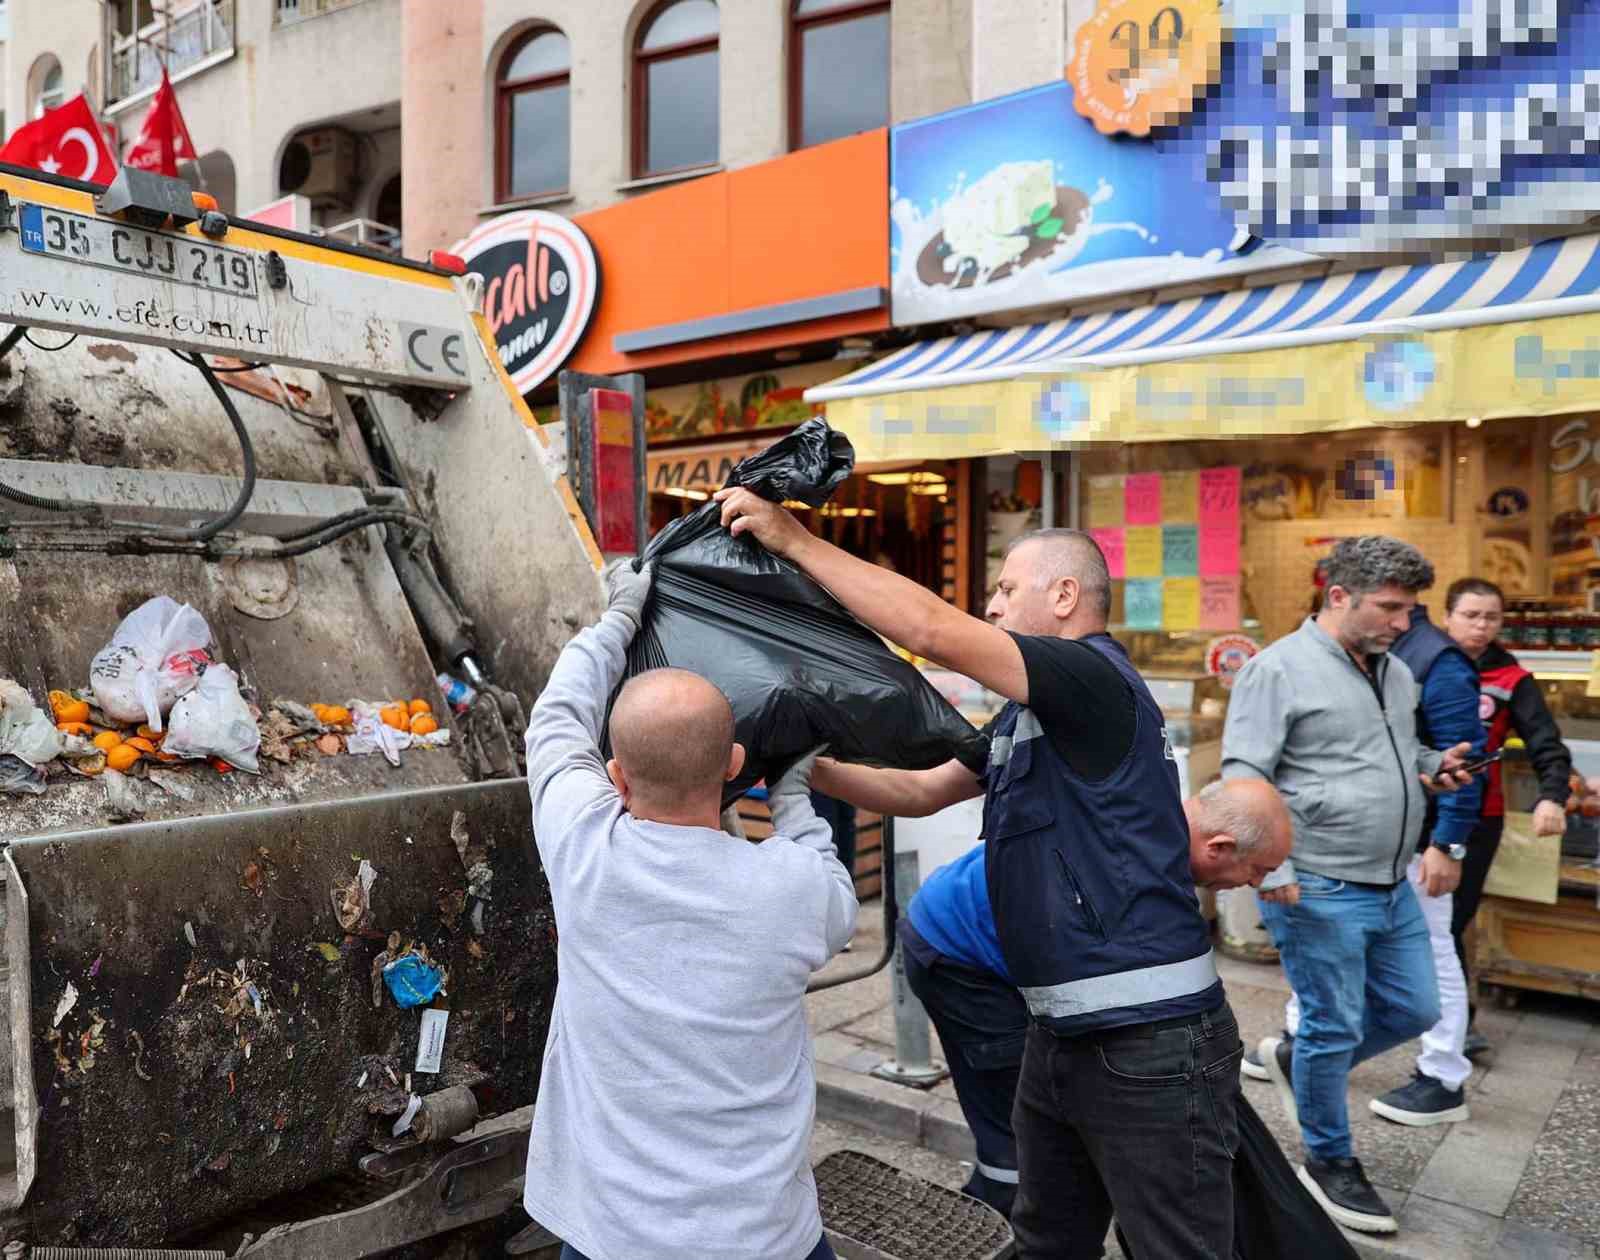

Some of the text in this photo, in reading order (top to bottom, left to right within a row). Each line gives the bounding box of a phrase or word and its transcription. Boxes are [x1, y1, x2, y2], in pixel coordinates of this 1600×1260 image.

[25, 229, 42, 242] TR
[46, 215, 249, 289] 35 CJJ 219
[20, 290, 269, 344] www.efe.com.tr
